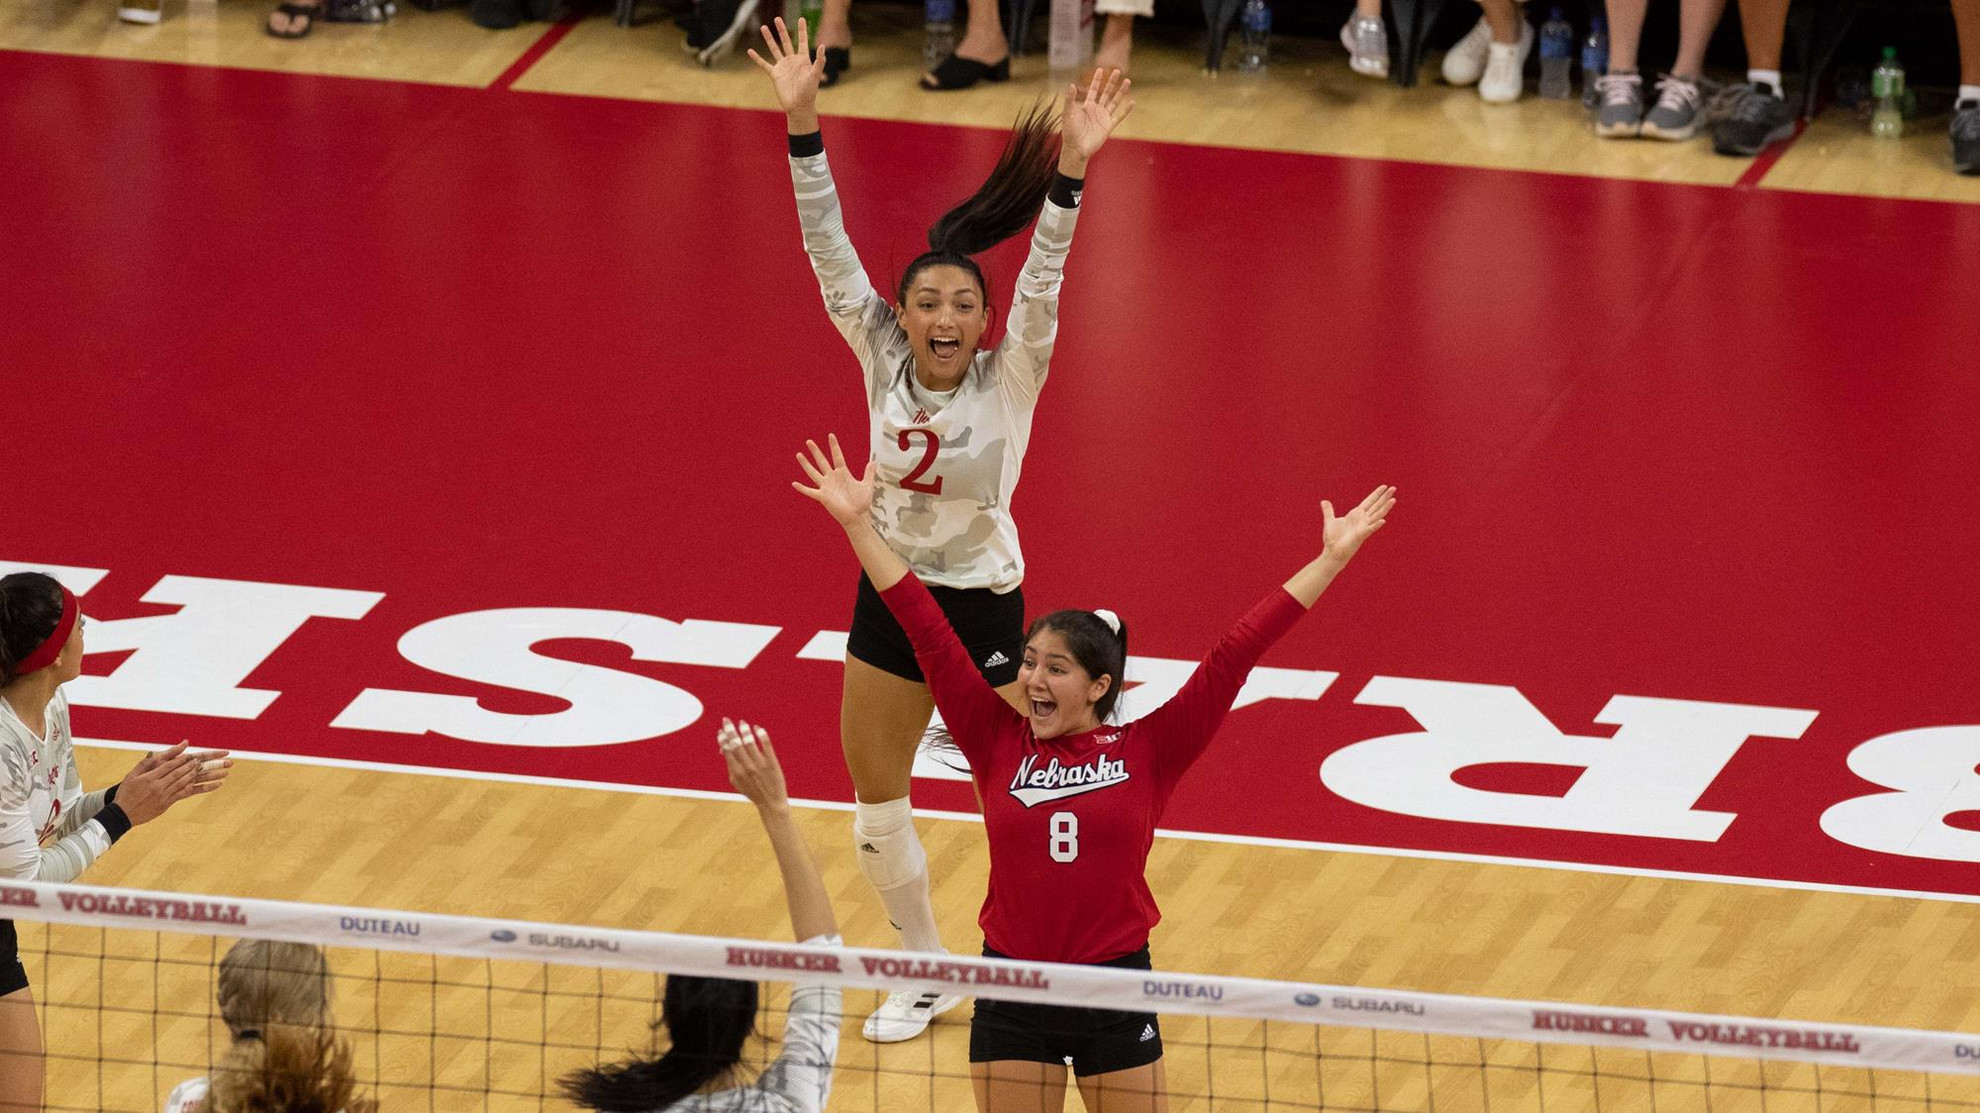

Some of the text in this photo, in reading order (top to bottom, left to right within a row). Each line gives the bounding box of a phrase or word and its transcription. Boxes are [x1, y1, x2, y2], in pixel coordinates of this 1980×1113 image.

[898, 428, 943, 495] 2
[1009, 752, 1126, 790] Nebraska
[1049, 810, 1079, 863] 8
[57, 891, 248, 925] VOLLEYBALL
[340, 915, 421, 937] DUTEAU
[528, 932, 621, 953] SUBARU
[726, 946, 1050, 990] HUSKER VOLLEYBALL
[1143, 980, 1224, 1001] DUTEAU
[1332, 996, 1426, 1017] SUBARU
[1532, 1009, 1860, 1053] HUSKER VOLLEYBALL
